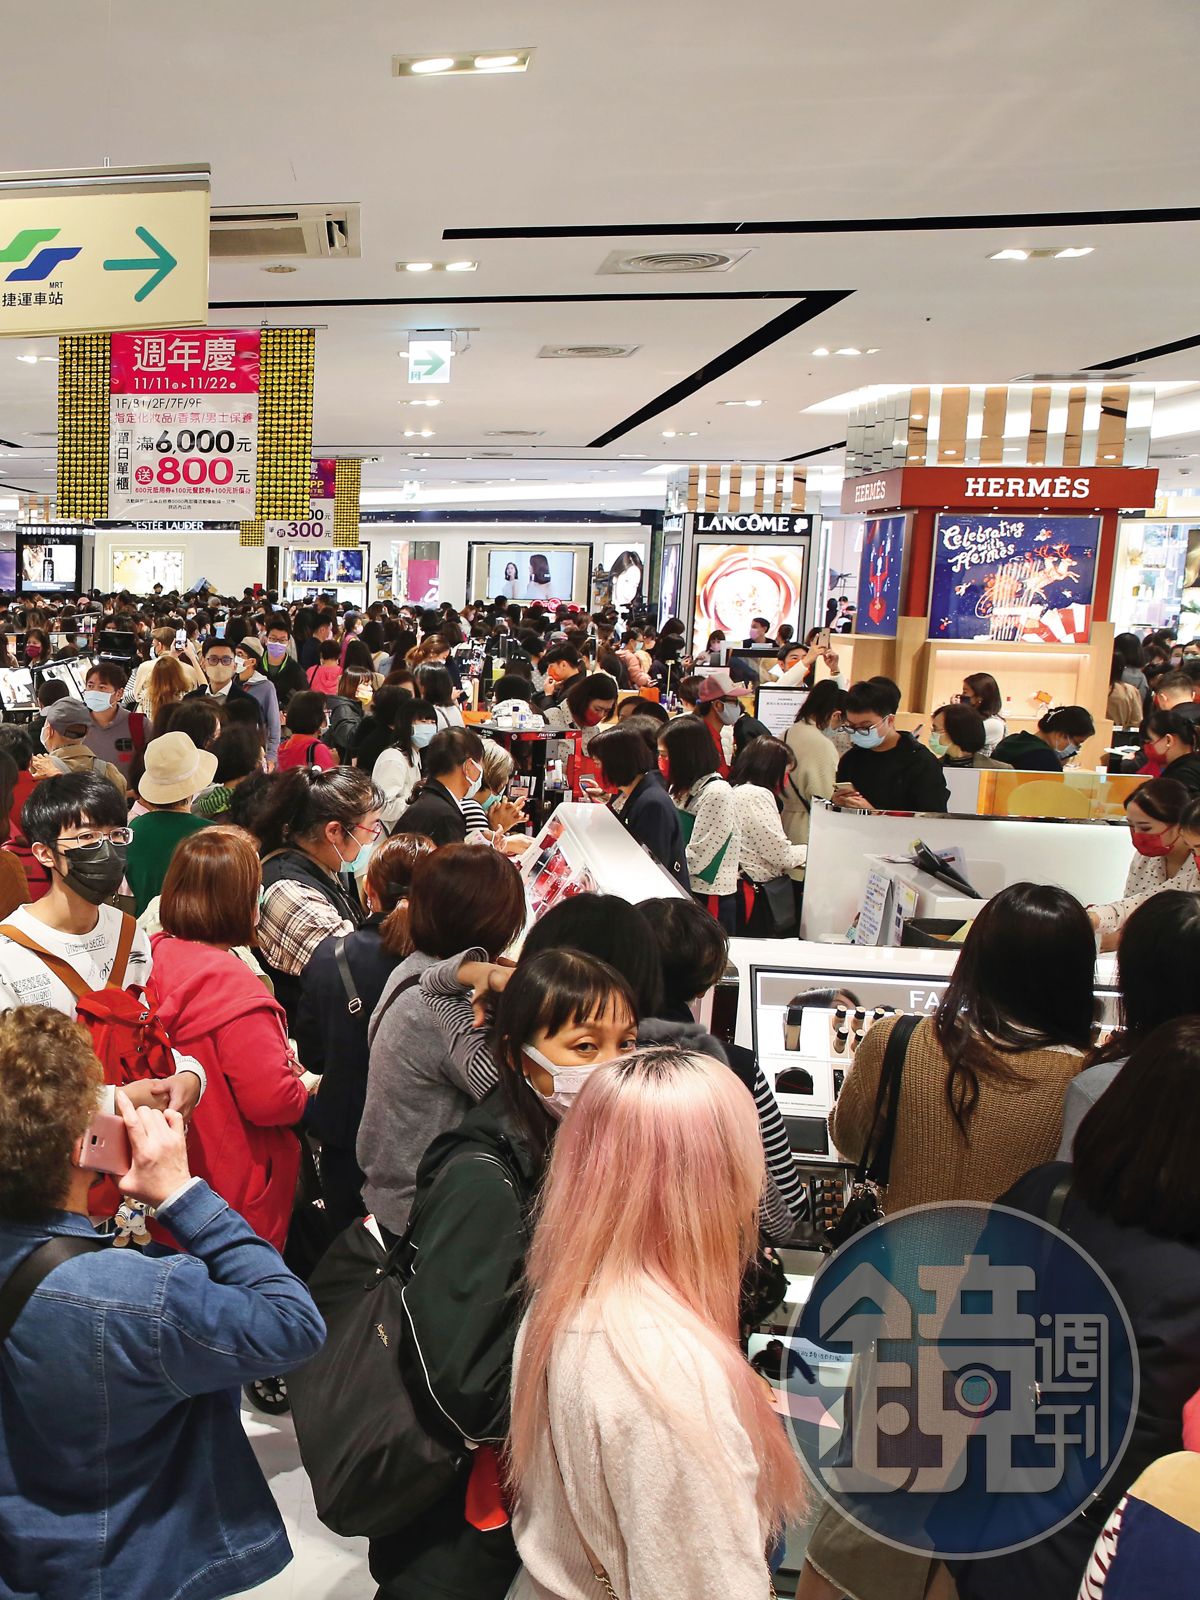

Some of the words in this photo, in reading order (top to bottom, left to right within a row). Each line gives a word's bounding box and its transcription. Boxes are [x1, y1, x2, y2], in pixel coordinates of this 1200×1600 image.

[48, 281, 64, 289] MRT
[2, 291, 64, 307] 捷運車站
[132, 336, 237, 372] 週年慶
[116, 432, 130, 491] 單日單櫃
[964, 476, 1091, 499] HERMÈS
[165, 521, 204, 531] LAUDER
[698, 513, 790, 532] LANCÔME
[940, 520, 1025, 551] Celebrating
